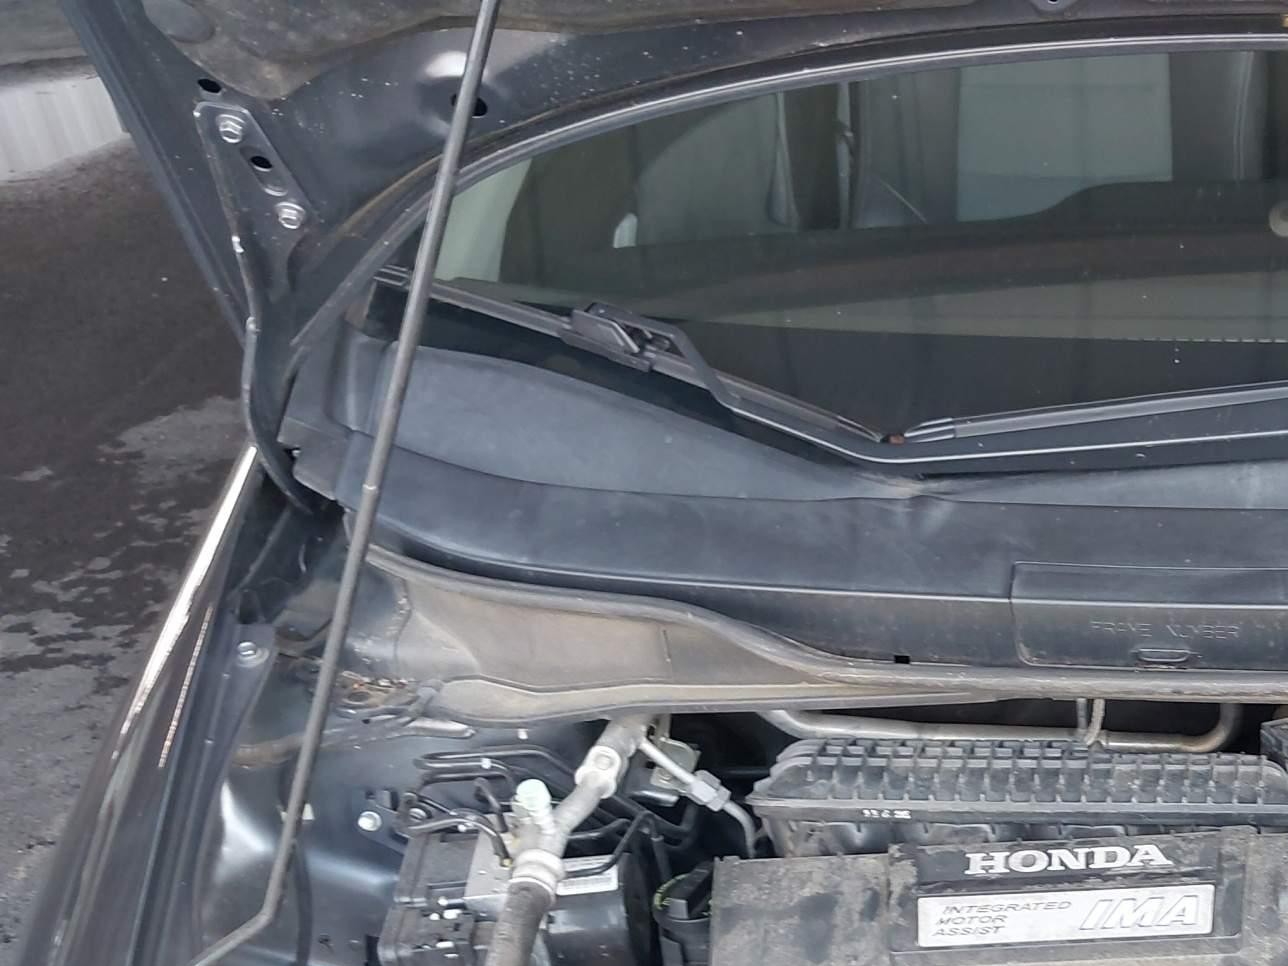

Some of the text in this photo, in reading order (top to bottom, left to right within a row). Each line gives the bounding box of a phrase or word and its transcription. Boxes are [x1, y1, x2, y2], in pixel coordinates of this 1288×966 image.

[965, 844, 1174, 875] HONDA
[942, 900, 1073, 914] INTEGRATED
[1079, 894, 1199, 932] IMA
[936, 914, 1008, 926] MOTOR
[931, 925, 1003, 937] ASSIST
